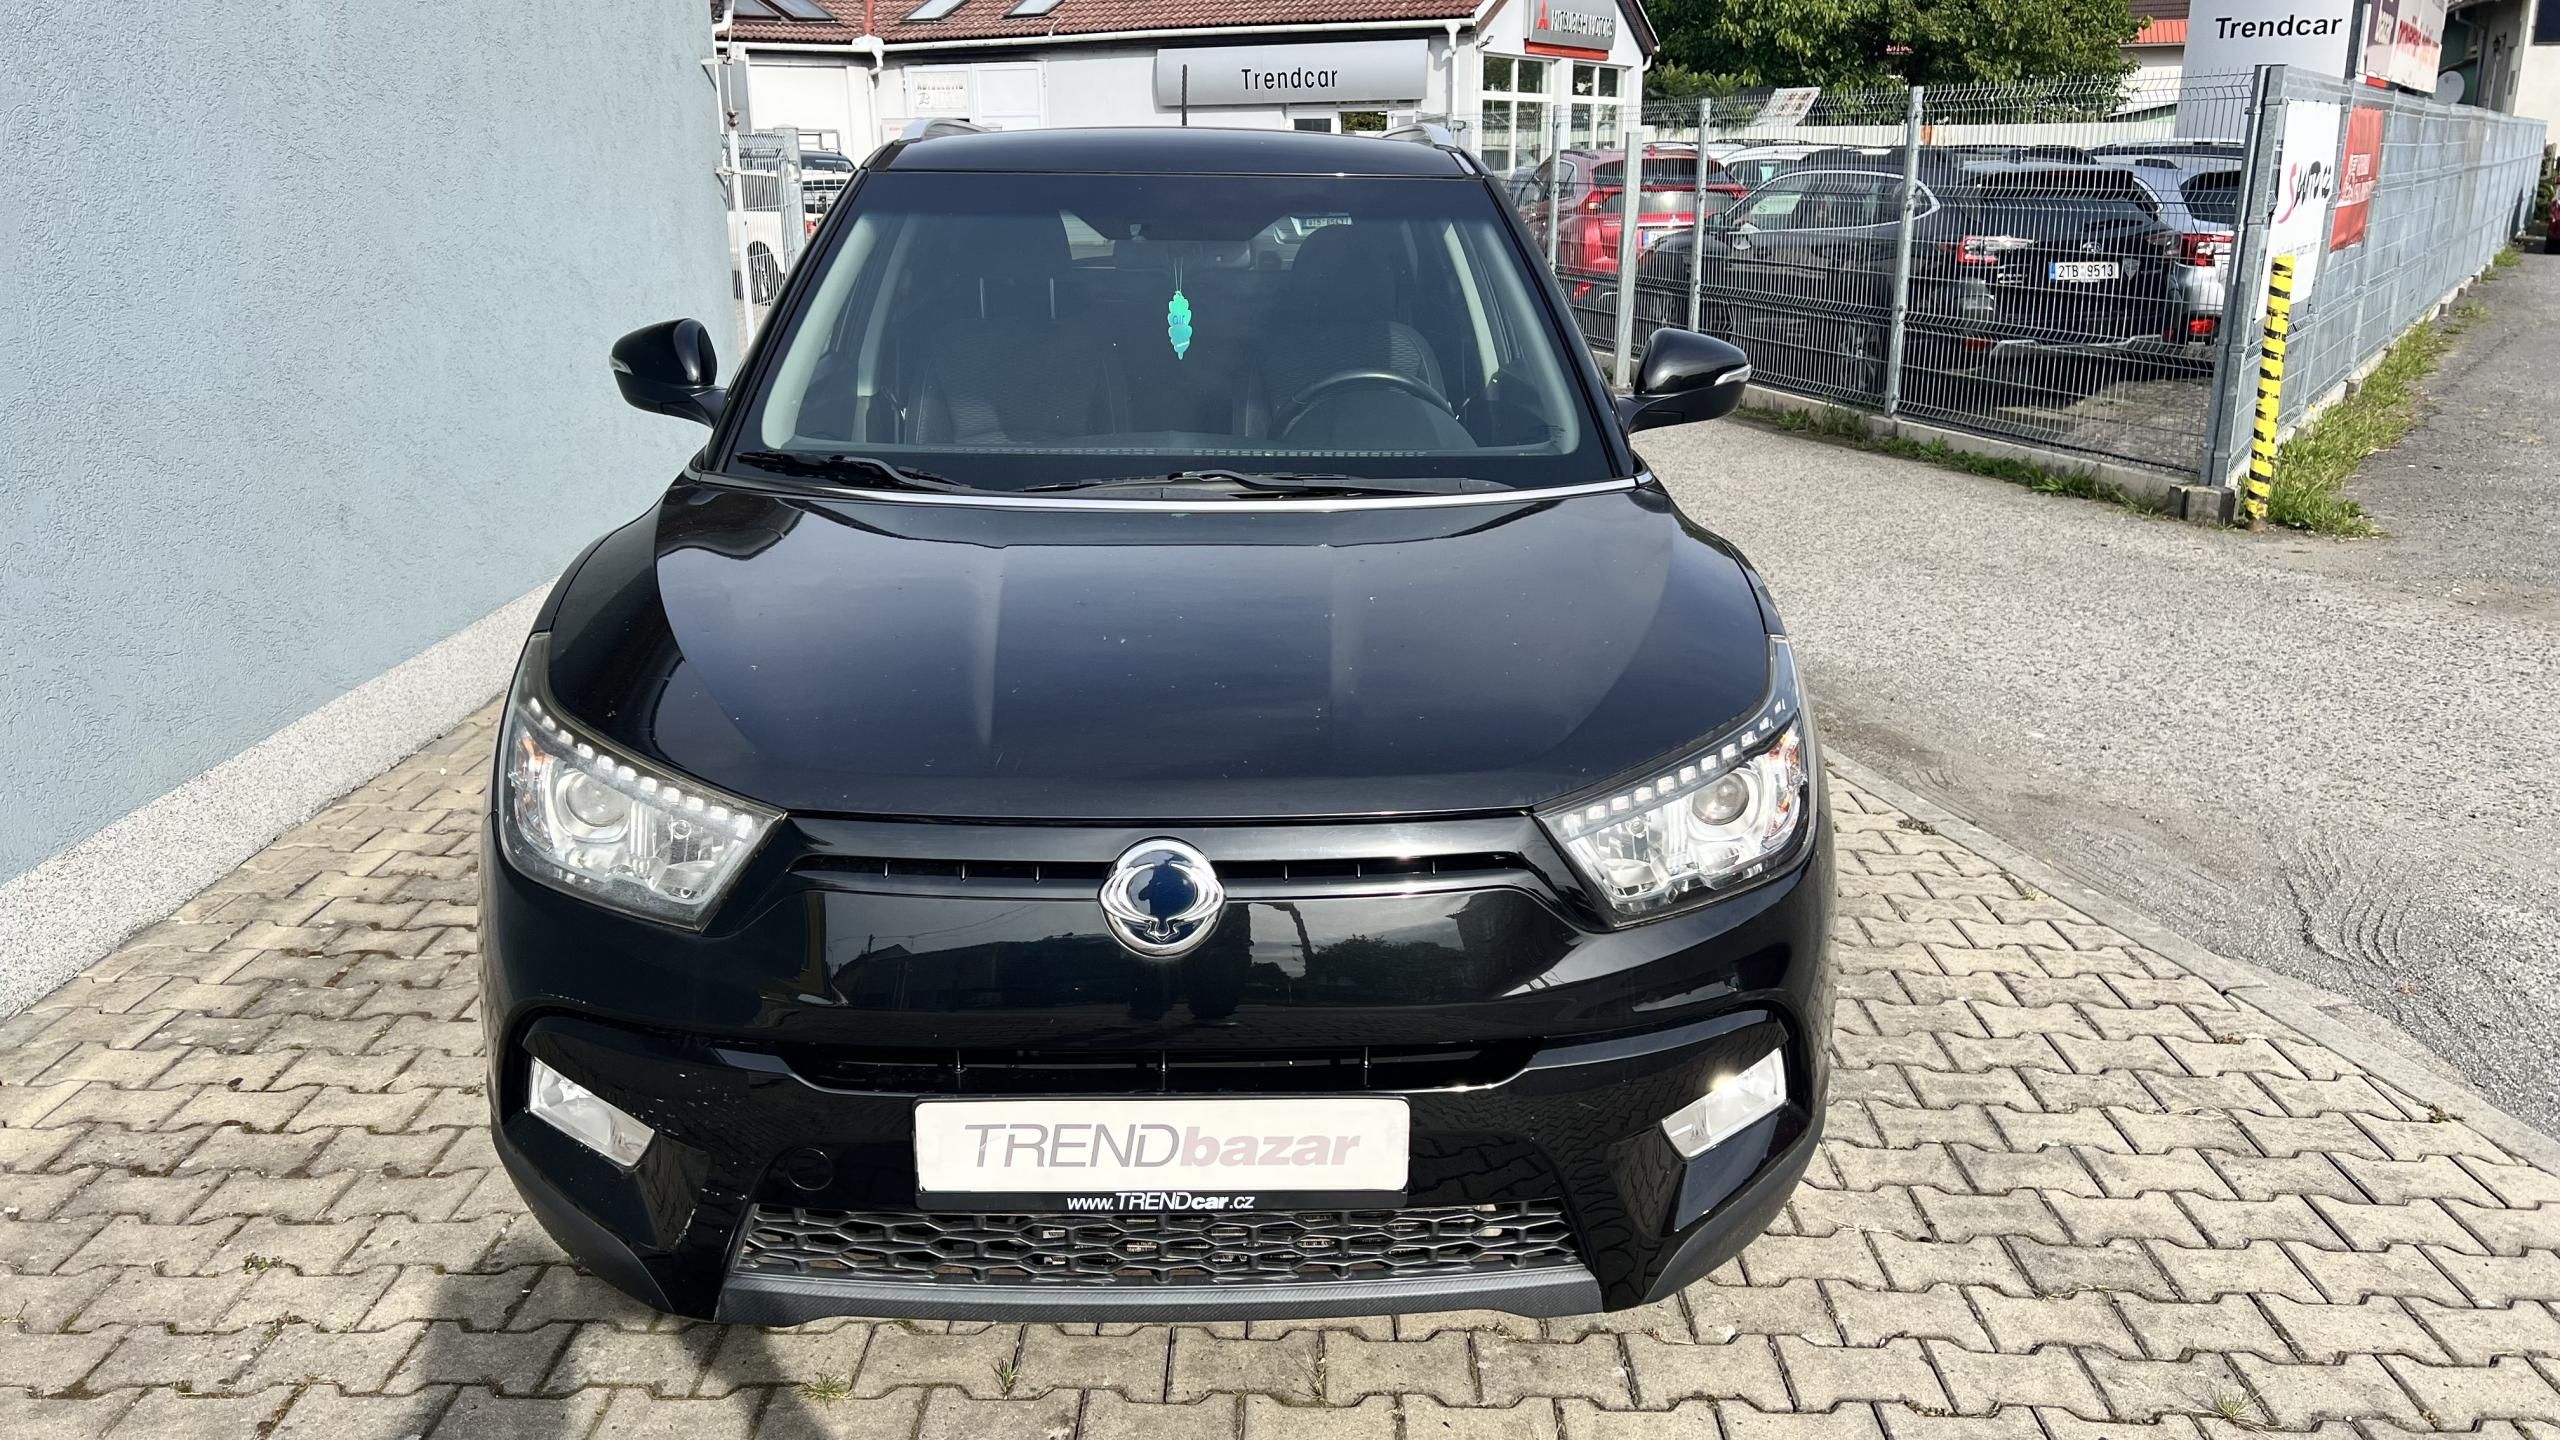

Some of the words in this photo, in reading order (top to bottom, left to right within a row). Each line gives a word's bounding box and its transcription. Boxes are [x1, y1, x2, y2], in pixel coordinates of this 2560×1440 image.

[2215, 14, 2343, 39] Trendcar
[1241, 67, 1338, 90] Trendcar
[2058, 264, 2079, 278] 2TB
[2087, 263, 2113, 278] 9513
[964, 1123, 1360, 1168] TRENDbazar
[1067, 1191, 1255, 1211] www.TRENDcar.cz
